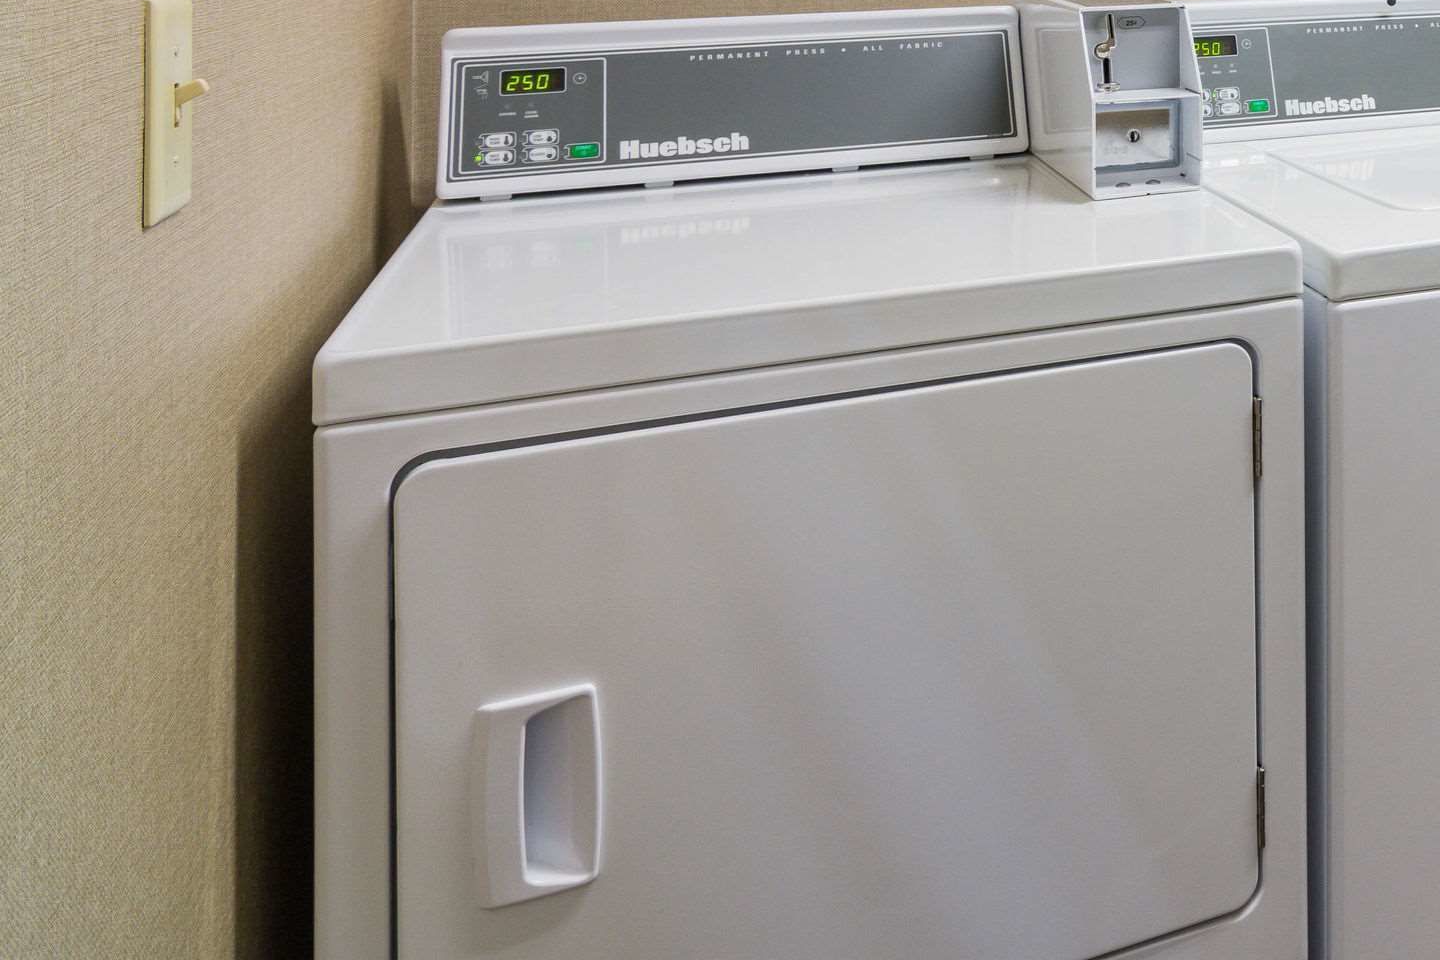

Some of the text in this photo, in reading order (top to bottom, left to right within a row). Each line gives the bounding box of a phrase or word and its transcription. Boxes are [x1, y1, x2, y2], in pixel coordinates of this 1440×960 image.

[1306, 25, 1364, 34] PERMANENT
[1375, 23, 1404, 31] PRESS
[690, 41, 943, 61] PERMANENT PRESS ALL FABRIC
[506, 74, 549, 91] 250
[1285, 94, 1376, 116] Huebsch
[620, 132, 749, 160] Huebsch
